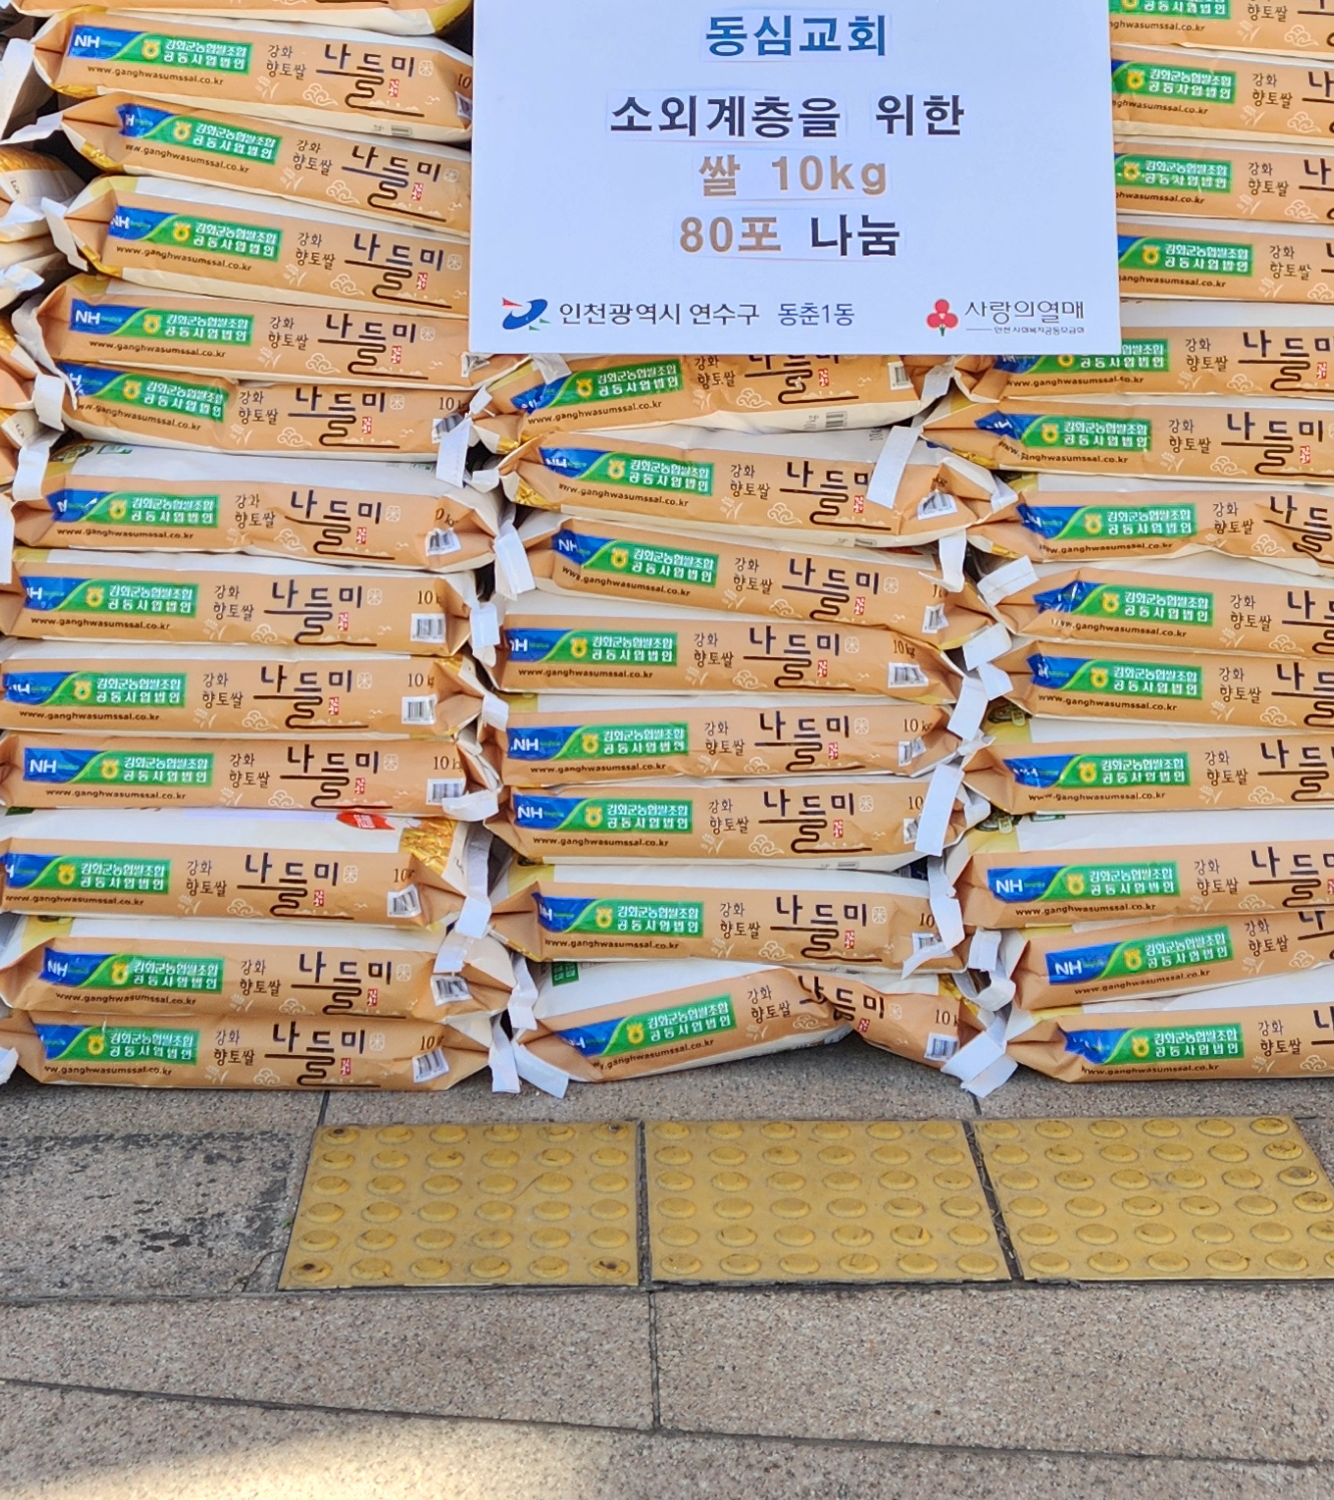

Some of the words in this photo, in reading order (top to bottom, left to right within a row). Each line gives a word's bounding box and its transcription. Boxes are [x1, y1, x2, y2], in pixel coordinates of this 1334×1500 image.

[705, 14, 887, 57] 동심교회
[611, 95, 841, 138] 소외계층을
[876, 94, 965, 137] 위한
[698, 154, 740, 198] 쌀
[770, 155, 888, 196] 10kg
[680, 216, 782, 253] 80포
[810, 214, 901, 257] 나눔
[559, 301, 681, 327] 인천광역시
[689, 301, 760, 327] 연수구
[777, 302, 855, 327] 동춘1동
[965, 300, 1084, 325] 사랑의열매
[704, 721, 729, 735] 강화
[513, 738, 540, 752] NH
[603, 739, 684, 754] 공동사업법인
[705, 740, 744, 756] 향토쌀
[29, 758, 57, 773] NH
[230, 753, 255, 767] 강화
[433, 756, 448, 770] 10
[530, 762, 666, 774] www.ganghwasumssal.co.kr
[123, 769, 207, 783] 공동사업법인
[229, 770, 270, 788] 향토쌀
[46, 788, 186, 800] www.ganghwasumssal.co.kr
[1195, 860, 1220, 874] 강화
[995, 880, 1023, 893] NH
[1090, 880, 1174, 895] 공동사업법인
[1197, 878, 1238, 895] 향토쌀
[1016, 904, 1155, 916] www.ganghwasumssal.co.kr
